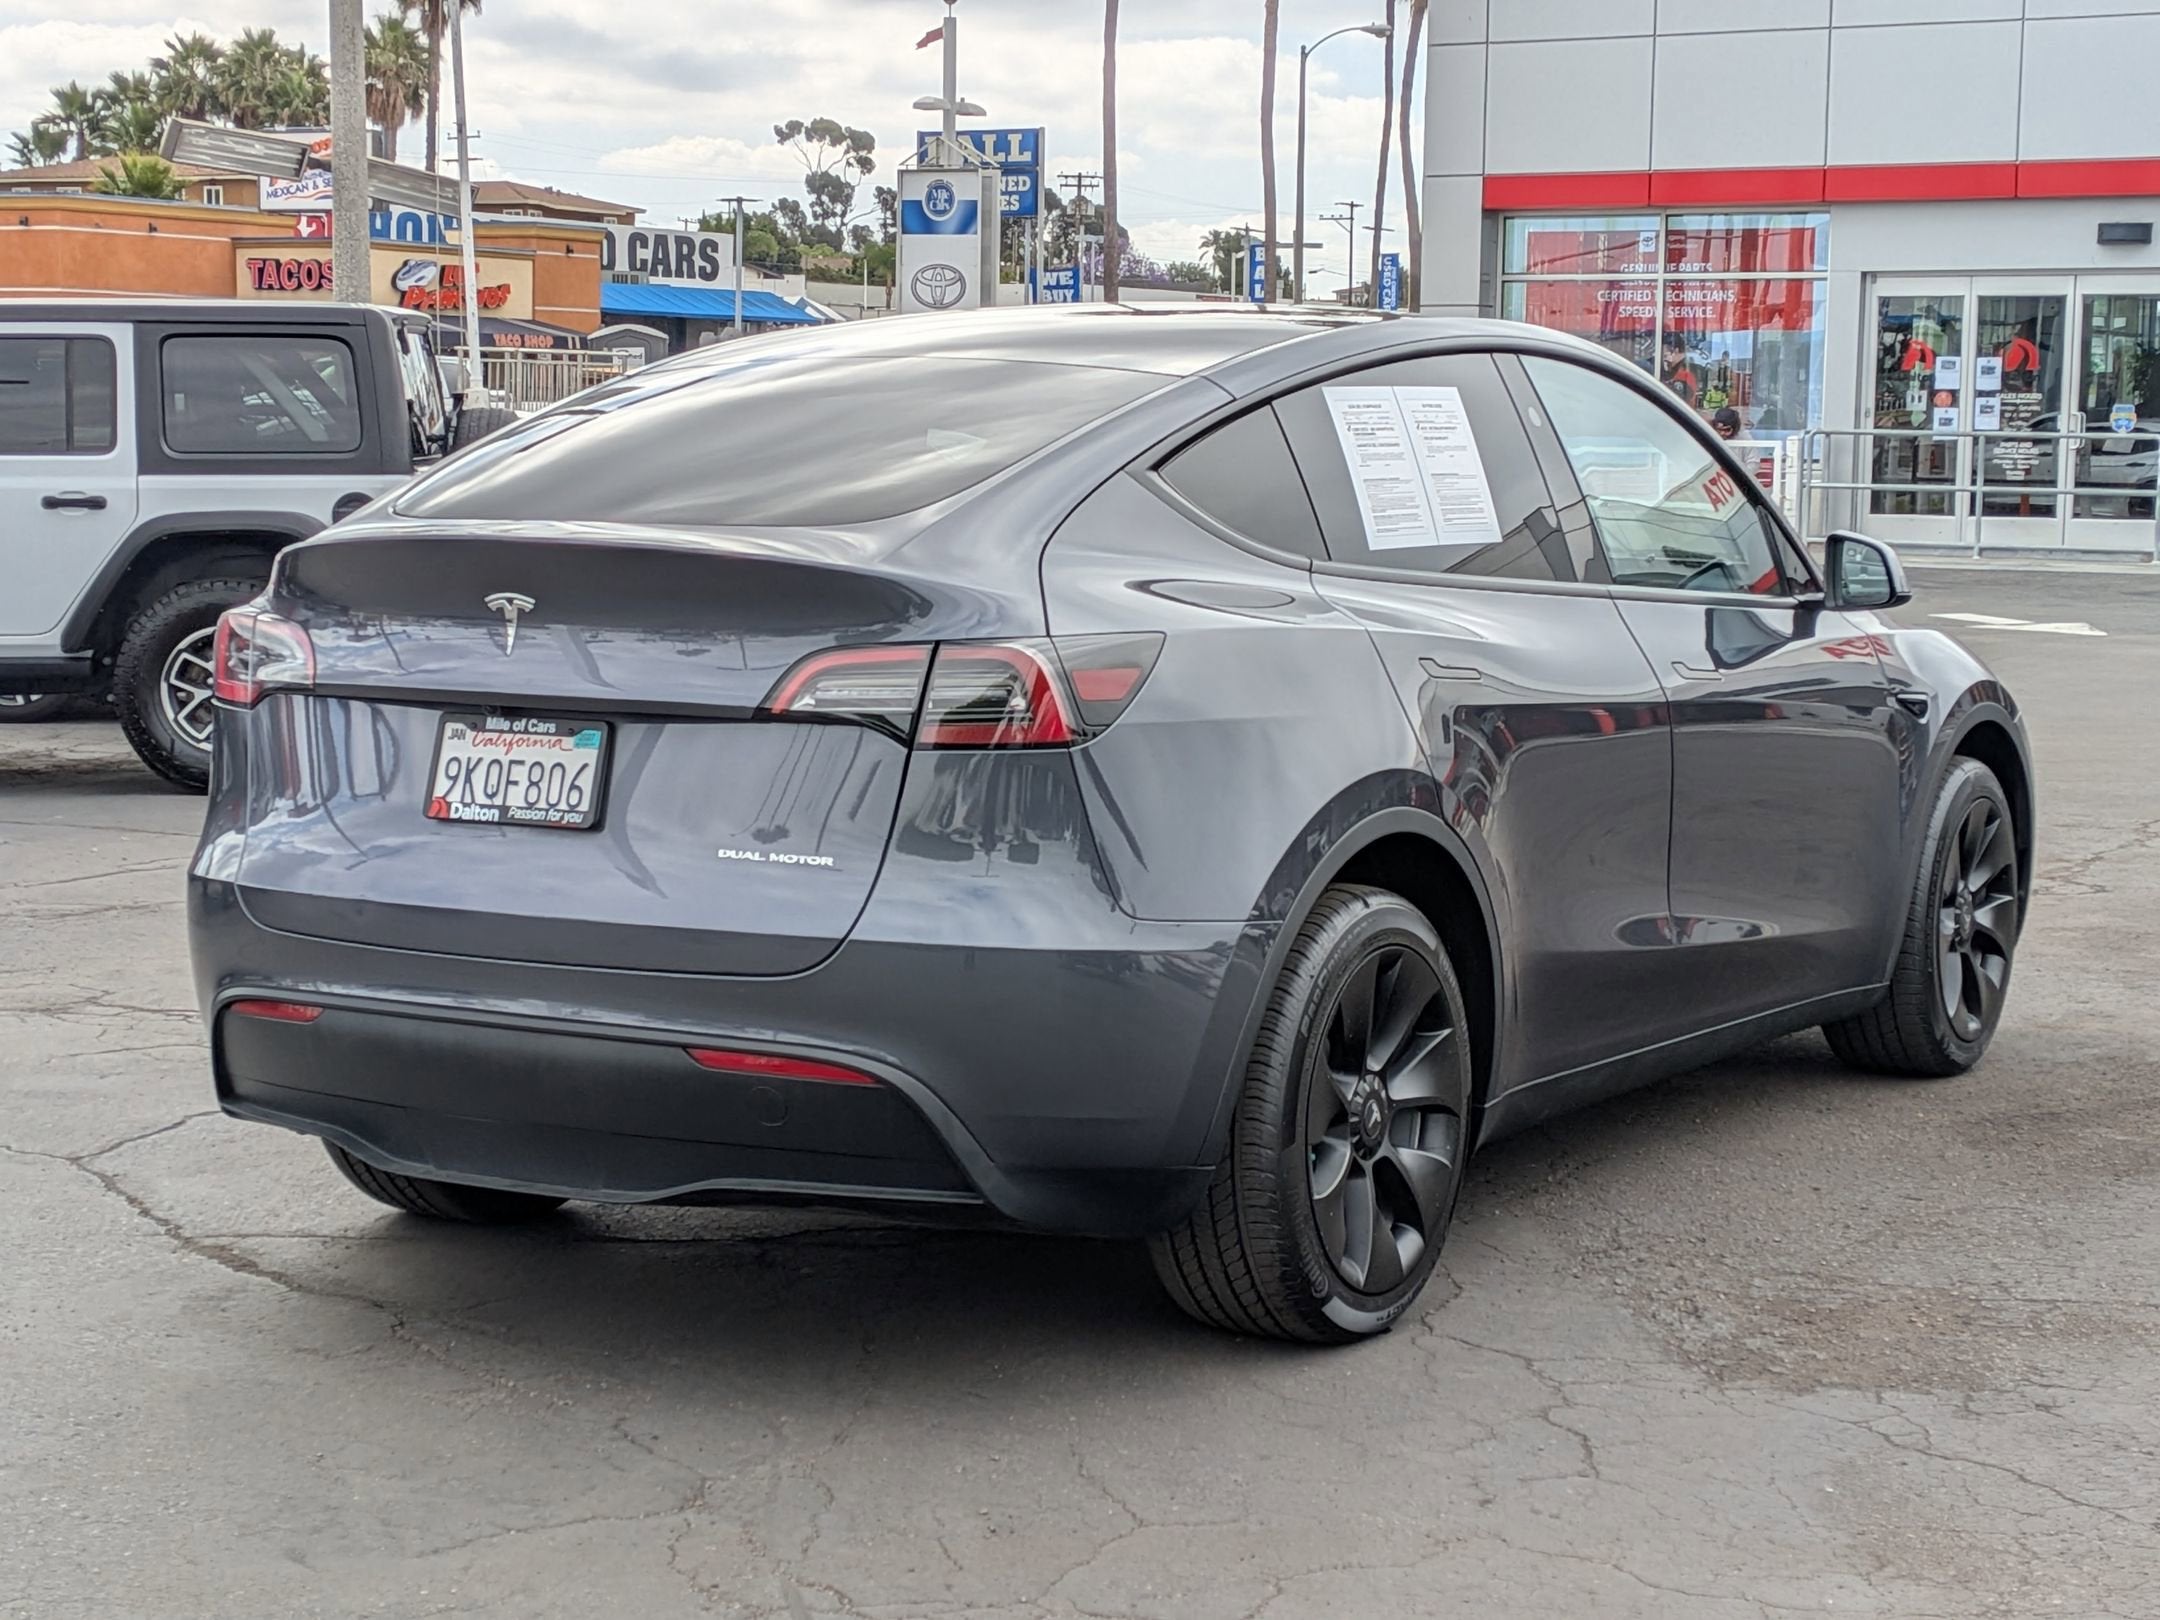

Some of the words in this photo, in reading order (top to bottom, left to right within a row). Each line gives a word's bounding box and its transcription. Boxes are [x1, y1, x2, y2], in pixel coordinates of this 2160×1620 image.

[266, 182, 309, 199] MEXICAN
[628, 232, 720, 282] CARS
[247, 259, 333, 290] TACOS
[1043, 271, 1074, 286] WE
[1042, 289, 1075, 303] BUY
[1597, 290, 1651, 302] CERTIFIED
[493, 333, 521, 347] TACO
[525, 334, 553, 348] SHOP
[448, 728, 467, 740] JAN
[485, 717, 511, 731] Mile
[513, 718, 526, 732] of
[527, 720, 556, 734] Cars
[472, 730, 573, 756] California
[444, 756, 589, 810] 9KQF806
[450, 802, 500, 822] Dalton
[507, 806, 548, 820] Passion
[548, 808, 563, 823] for
[562, 811, 585, 824] you
[718, 849, 766, 861] DUAL
[769, 853, 834, 866] MOTOR
